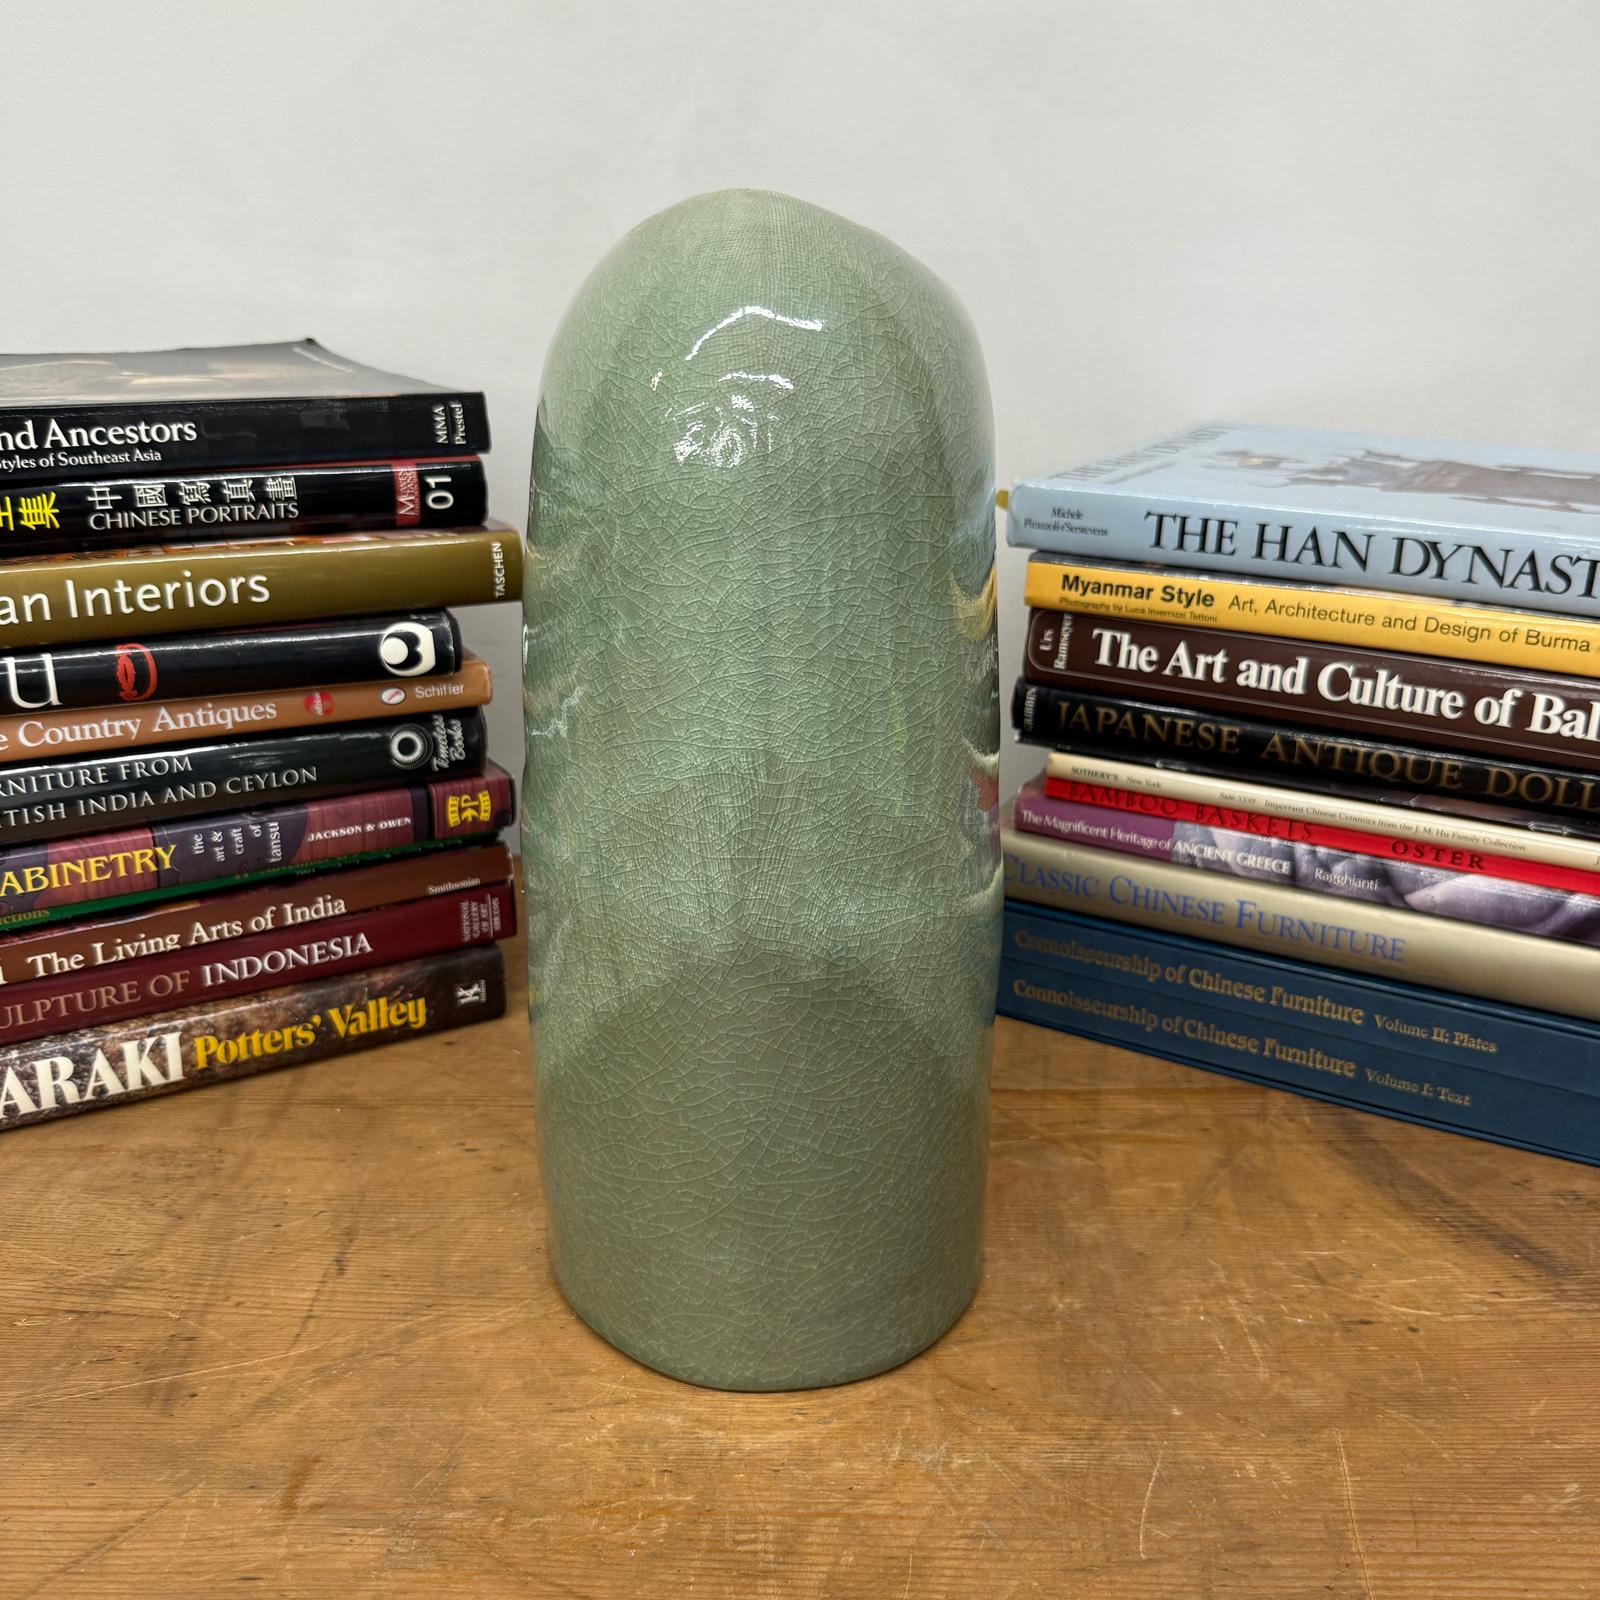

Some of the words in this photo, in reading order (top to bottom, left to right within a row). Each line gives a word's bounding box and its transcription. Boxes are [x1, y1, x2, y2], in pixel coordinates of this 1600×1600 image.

[44, 418, 197, 449] Ancestors
[432, 403, 448, 444] MMA
[449, 401, 467, 445] Prestel
[0, 453, 36, 473] tyles
[39, 451, 54, 468] of
[58, 449, 131, 467] Southeast
[133, 447, 162, 462] Asia
[90, 506, 182, 531] CHINESE
[188, 501, 299, 525] PORTRAITS
[424, 475, 454, 510] 01
[491, 542, 506, 598] TASCHEN
[1144, 510, 1238, 556] THE
[1251, 522, 1376, 573] HAN
[1389, 536, 1600, 600] DYNAST
[65, 570, 270, 619] Interiors
[1059, 597, 1111, 612] Photography
[1112, 602, 1123, 613] by
[1125, 604, 1146, 615] Luca
[1061, 574, 1154, 600] Myanmar
[1161, 585, 1215, 609] Style
[1228, 595, 1259, 616] Art,
[1265, 600, 1375, 627] Architecture
[1381, 613, 1416, 632] and
[1424, 616, 1491, 643] Design
[1499, 627, 1518, 644] of
[1525, 628, 1590, 652] Burma
[415, 684, 465, 699] Schiffer
[1092, 628, 1159, 672] The
[1162, 640, 1229, 683] Art
[1236, 656, 1307, 695] and
[1317, 662, 1464, 720] Culture
[1474, 688, 1522, 728] of
[18, 717, 142, 748] Country
[152, 701, 277, 733] Antiques
[119, 756, 193, 781] FROM
[1056, 700, 1240, 753] JAPANESE
[1260, 733, 1463, 789] ANTIQUE
[1484, 766, 1600, 813] DOLL
[79, 791, 154, 817] INDIA
[164, 780, 216, 806] AND
[225, 766, 318, 795] CEYLON
[193, 832, 205, 856] the
[230, 828, 244, 855] craft
[268, 821, 283, 864] tansu
[308, 824, 362, 843] JACKSON
[367, 822, 377, 833] &
[379, 816, 412, 831] OWEN
[1022, 810, 1042, 826] The
[1043, 817, 1108, 839] Magnificent
[1109, 828, 1159, 850] Heritage
[1158, 839, 1173, 850] of
[1173, 840, 1233, 860] ANCIENT
[1236, 852, 1292, 875] GREECE
[1069, 782, 1178, 816] BAMBOO
[1195, 803, 1312, 841] BASKETS
[1391, 840, 1485, 870] OSTER
[0, 844, 178, 897] ABINETRY
[215, 845, 225, 863] art
[427, 876, 481, 896] Smithsonian
[1002, 852, 1099, 899] CLASSIC
[1109, 874, 1224, 925] CHINESE
[1235, 898, 1407, 963] FURNITURE
[26, 951, 86, 978] The
[92, 932, 181, 965] Living
[189, 920, 242, 947] Arts
[250, 905, 277, 931] of
[283, 894, 348, 925] India
[151, 970, 190, 998] OF
[201, 932, 374, 988] INDONESIA
[1013, 928, 1162, 981] Connoisseurship
[1164, 964, 1188, 984] of
[1188, 967, 1265, 1003] Chinese
[1269, 984, 1366, 1026] Furniture
[1373, 1013, 1429, 1041] Volume
[1453, 1031, 1498, 1055] Plates
[194, 1017, 321, 1071] Potters'
[328, 995, 428, 1040] Valley
[1012, 979, 1159, 1033] Connoisseurship
[1161, 1013, 1184, 1034] of
[1183, 1015, 1259, 1056] Chinese
[1262, 1036, 1357, 1079] Furniture
[1364, 1067, 1419, 1094] Volume
[1436, 1086, 1473, 1108] Text
